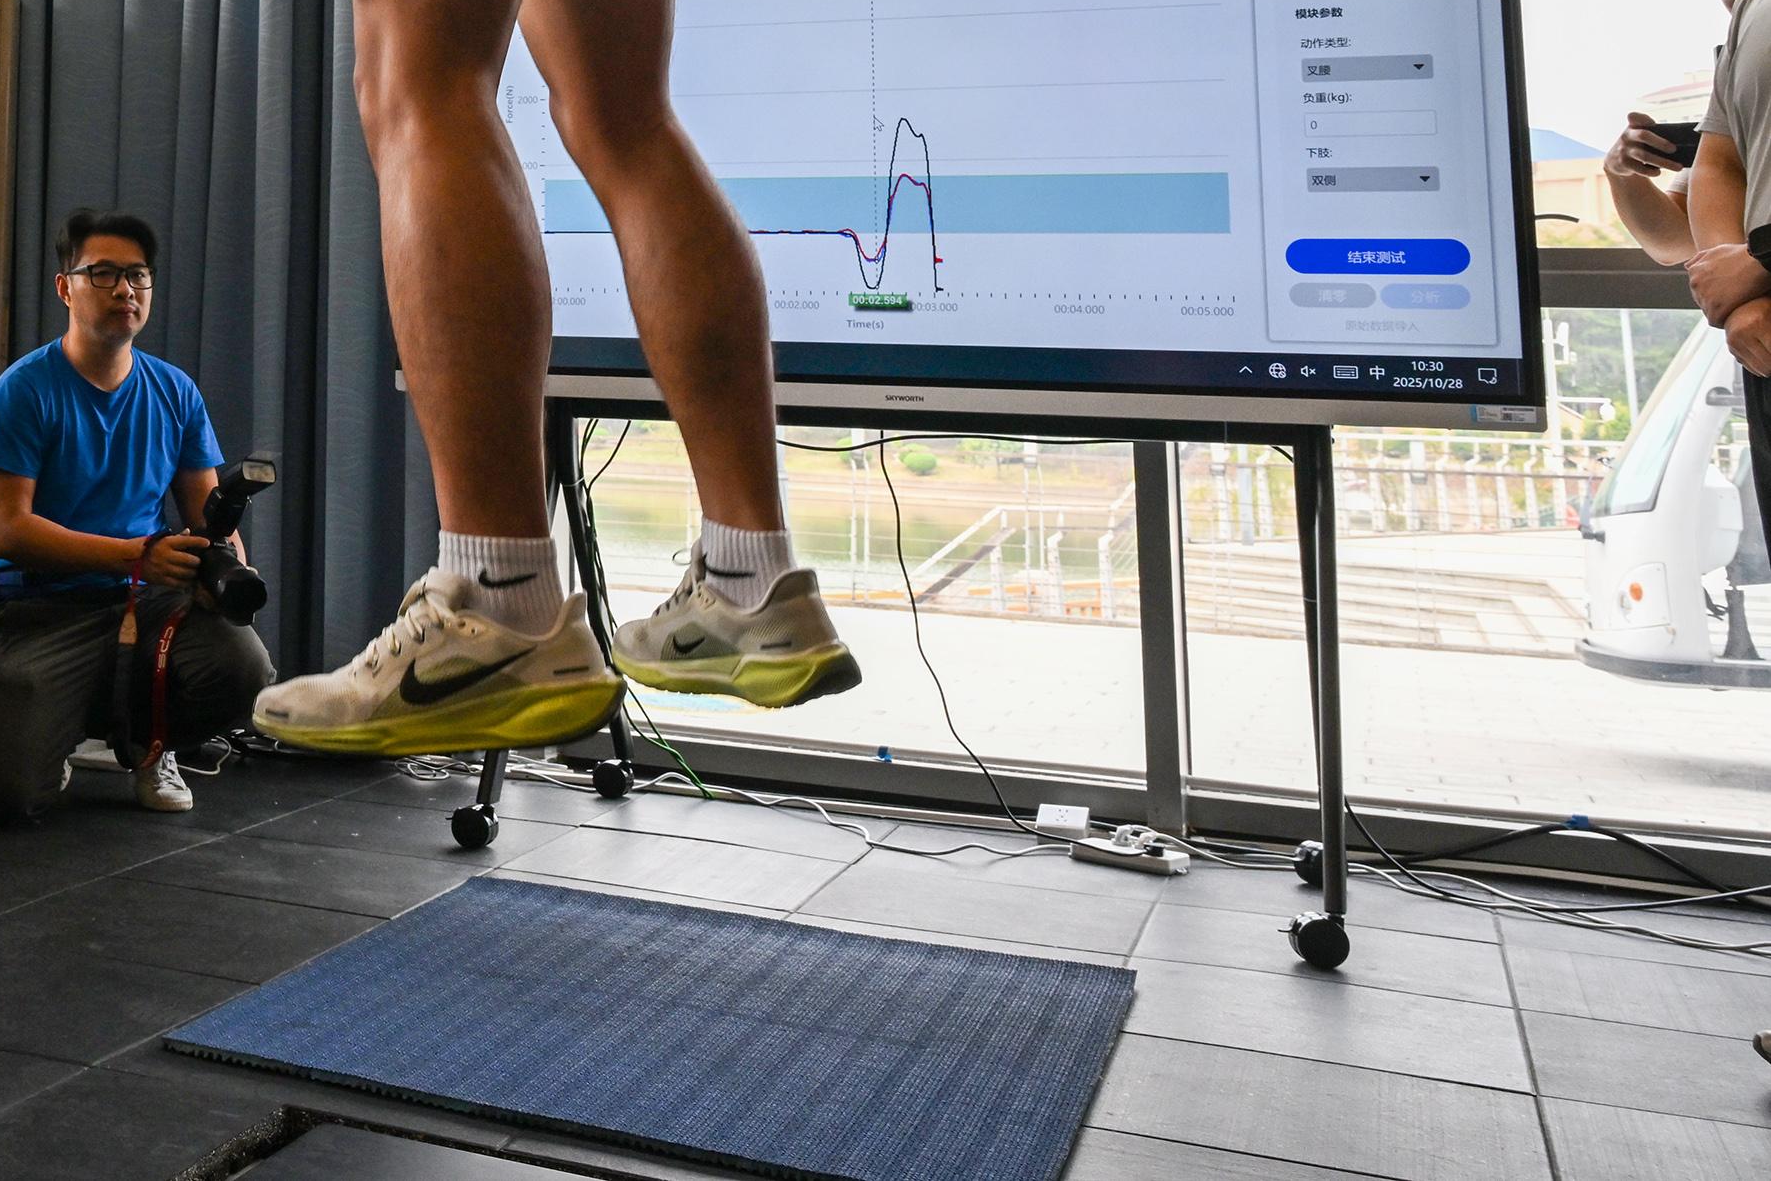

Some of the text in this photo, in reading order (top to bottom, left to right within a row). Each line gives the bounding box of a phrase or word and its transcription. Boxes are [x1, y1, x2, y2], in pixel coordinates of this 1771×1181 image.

[1295, 7, 1343, 19] 模块参数
[1300, 37, 1352, 49] 动作类型:
[1307, 65, 1331, 76] 叉腰
[517, 96, 538, 105] 2000
[1303, 92, 1352, 105] 负重(kg):
[506, 85, 515, 124] Force(N)
[1310, 120, 1318, 130] 0
[1306, 148, 1333, 159] 下肢:
[523, 162, 538, 170] 000
[1312, 175, 1337, 187] 双侧
[1347, 250, 1406, 264] 结束测试
[852, 295, 902, 305] 00:02.594
[1054, 305, 1105, 315] 00:04.000
[1181, 306, 1234, 316] 00:05.000
[847, 319, 885, 330] Time(s)
[1411, 360, 1444, 372] 10:30
[1369, 365, 1385, 380] 中
[1393, 377, 1463, 389] 2025/10/28
[885, 395, 924, 403] SKYWORTH
